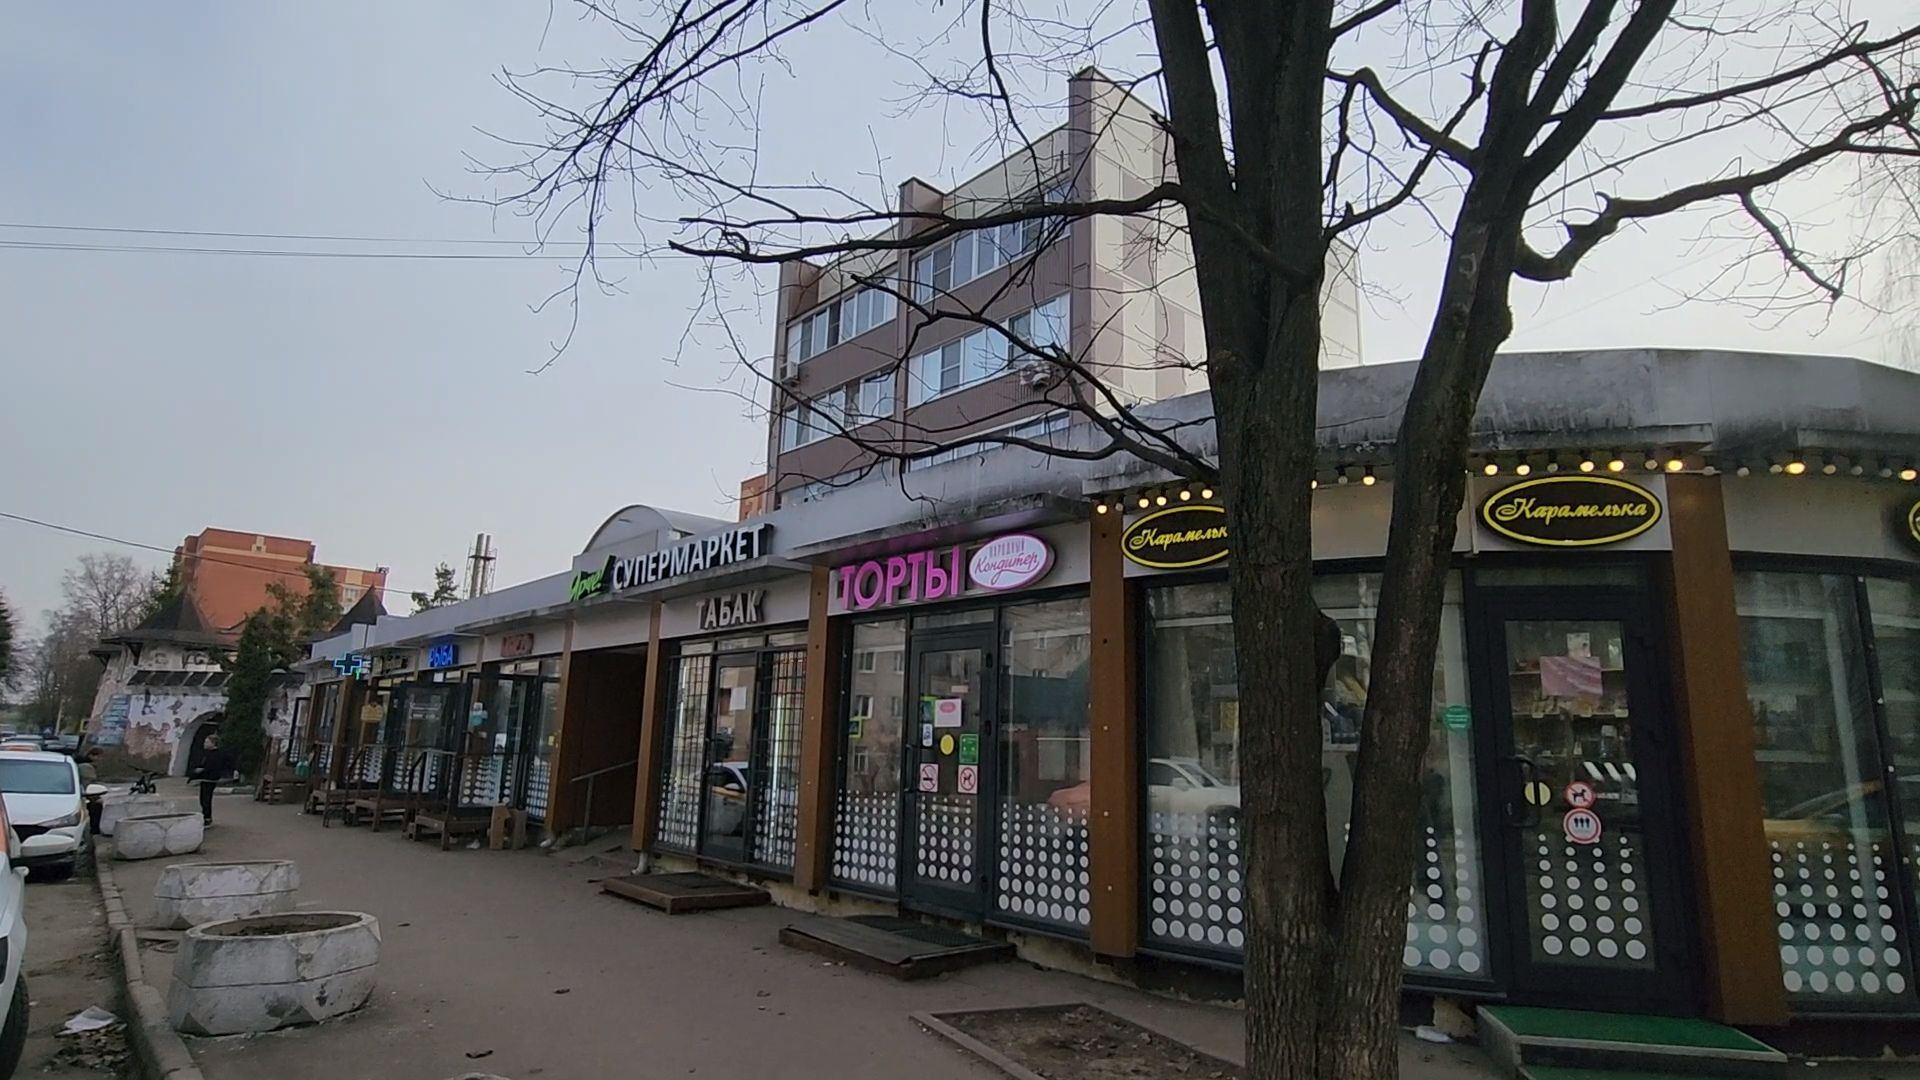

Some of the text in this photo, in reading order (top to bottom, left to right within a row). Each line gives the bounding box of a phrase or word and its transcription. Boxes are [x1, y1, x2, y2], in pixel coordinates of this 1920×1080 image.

[1495, 497, 1647, 526] Карамелька
[1128, 526, 1228, 551] Карамельк
[613, 523, 765, 590] СУПЕРМАРКЕТ
[974, 551, 1039, 585] Кондитер
[840, 545, 961, 610] ТОРТЫ
[696, 590, 759, 630] ТАБАК
[428, 645, 453, 667] РЫБА
